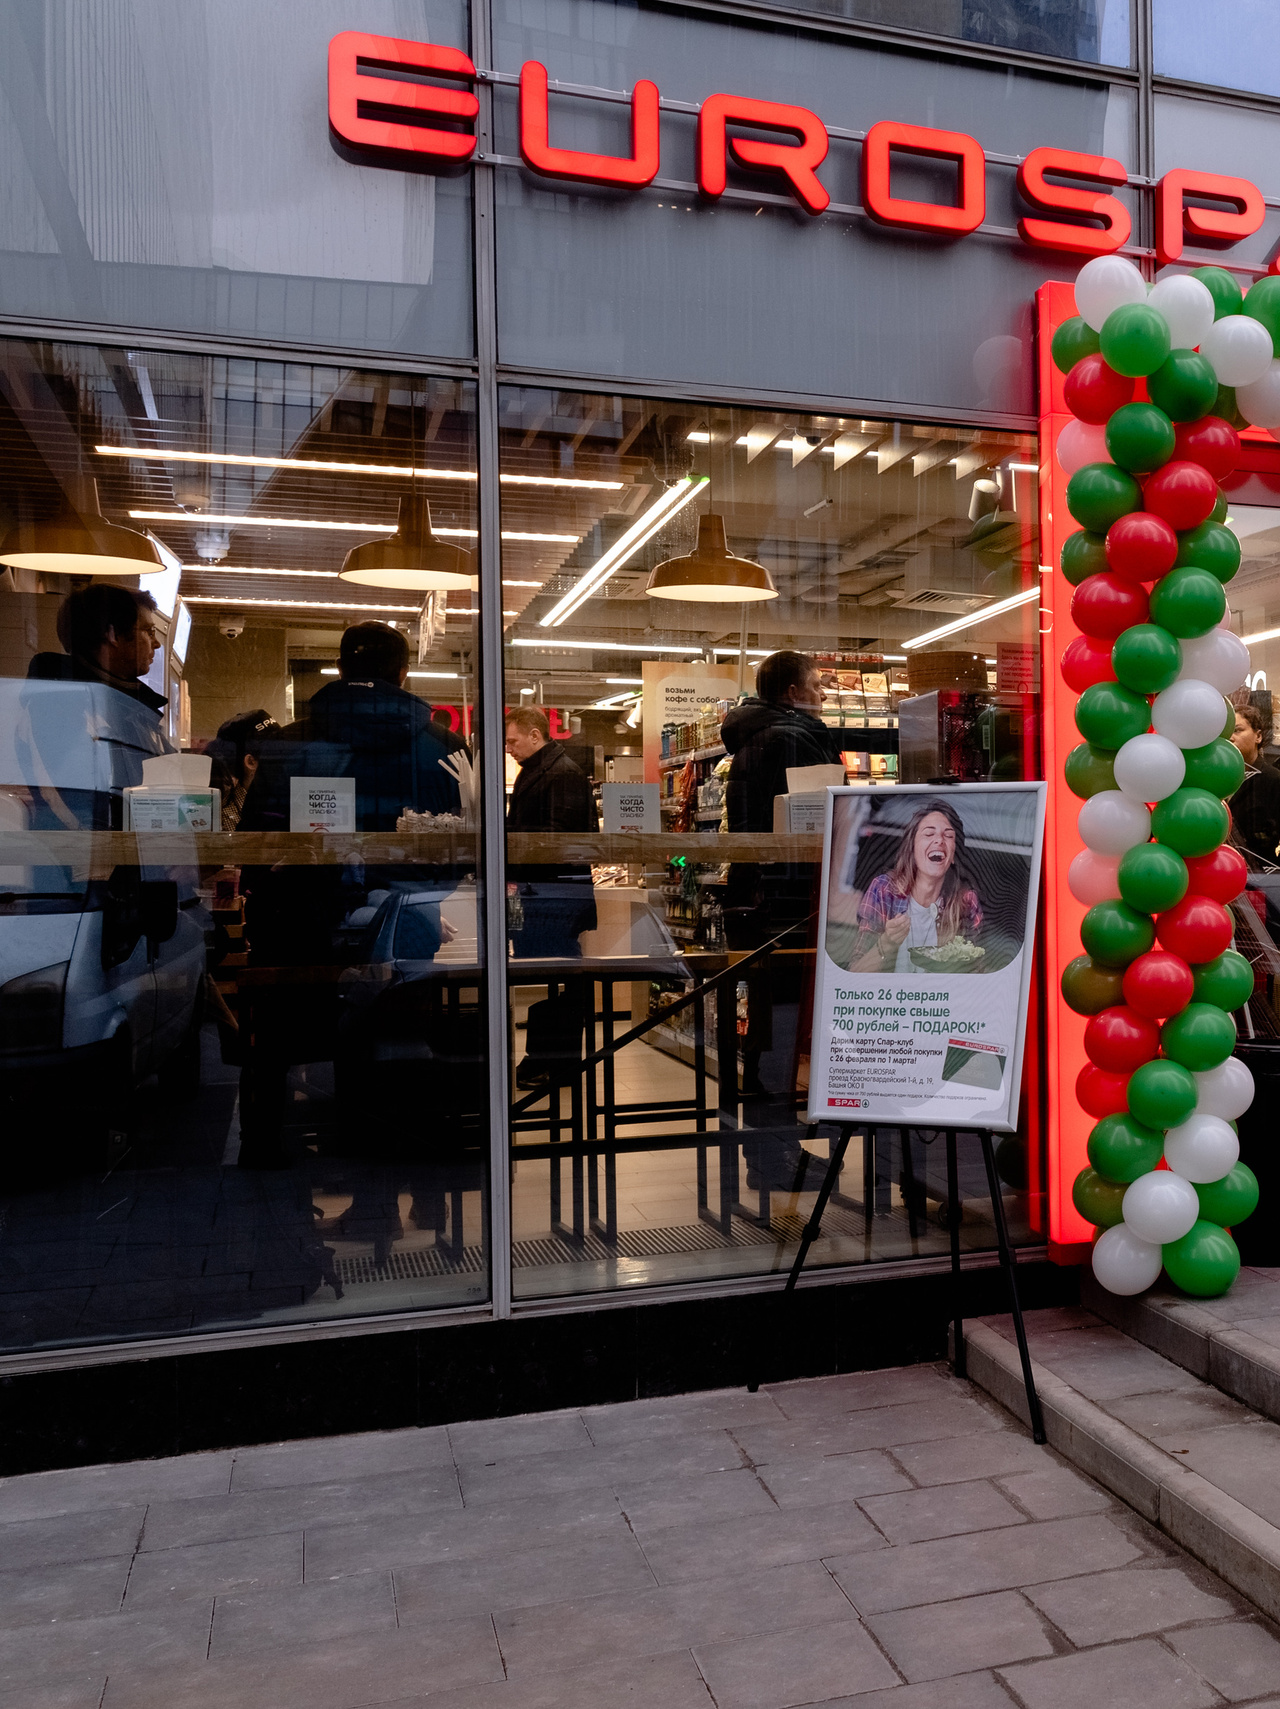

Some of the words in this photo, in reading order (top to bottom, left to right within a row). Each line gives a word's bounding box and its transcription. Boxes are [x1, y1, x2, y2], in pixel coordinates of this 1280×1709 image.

[665, 695, 688, 704] кофе
[834, 988, 874, 1000] Только
[877, 988, 892, 1000] 26
[896, 989, 949, 1004] февраля
[833, 1005, 855, 1018] при
[858, 1006, 907, 1019] покупке
[909, 1007, 950, 1017] свыше
[832, 1018, 854, 1031] 700
[856, 1020, 899, 1034] рублей
[830, 1037, 854, 1046] Дарим
[855, 1038, 876, 1047] карту
[877, 1037, 914, 1047] Спар-клуб
[888, 1047, 912, 1055] любой
[913, 1049, 943, 1057] покупки
[845, 1056, 877, 1065] февраля
[892, 1057, 917, 1066] марта!
[828, 1067, 866, 1076] Супермаркет
[866, 1068, 896, 1076] EUROSPAR
[828, 1075, 849, 1083] проезд
[849, 1075, 907, 1085] Красногвардейский
[828, 1081, 846, 1089] Башня
